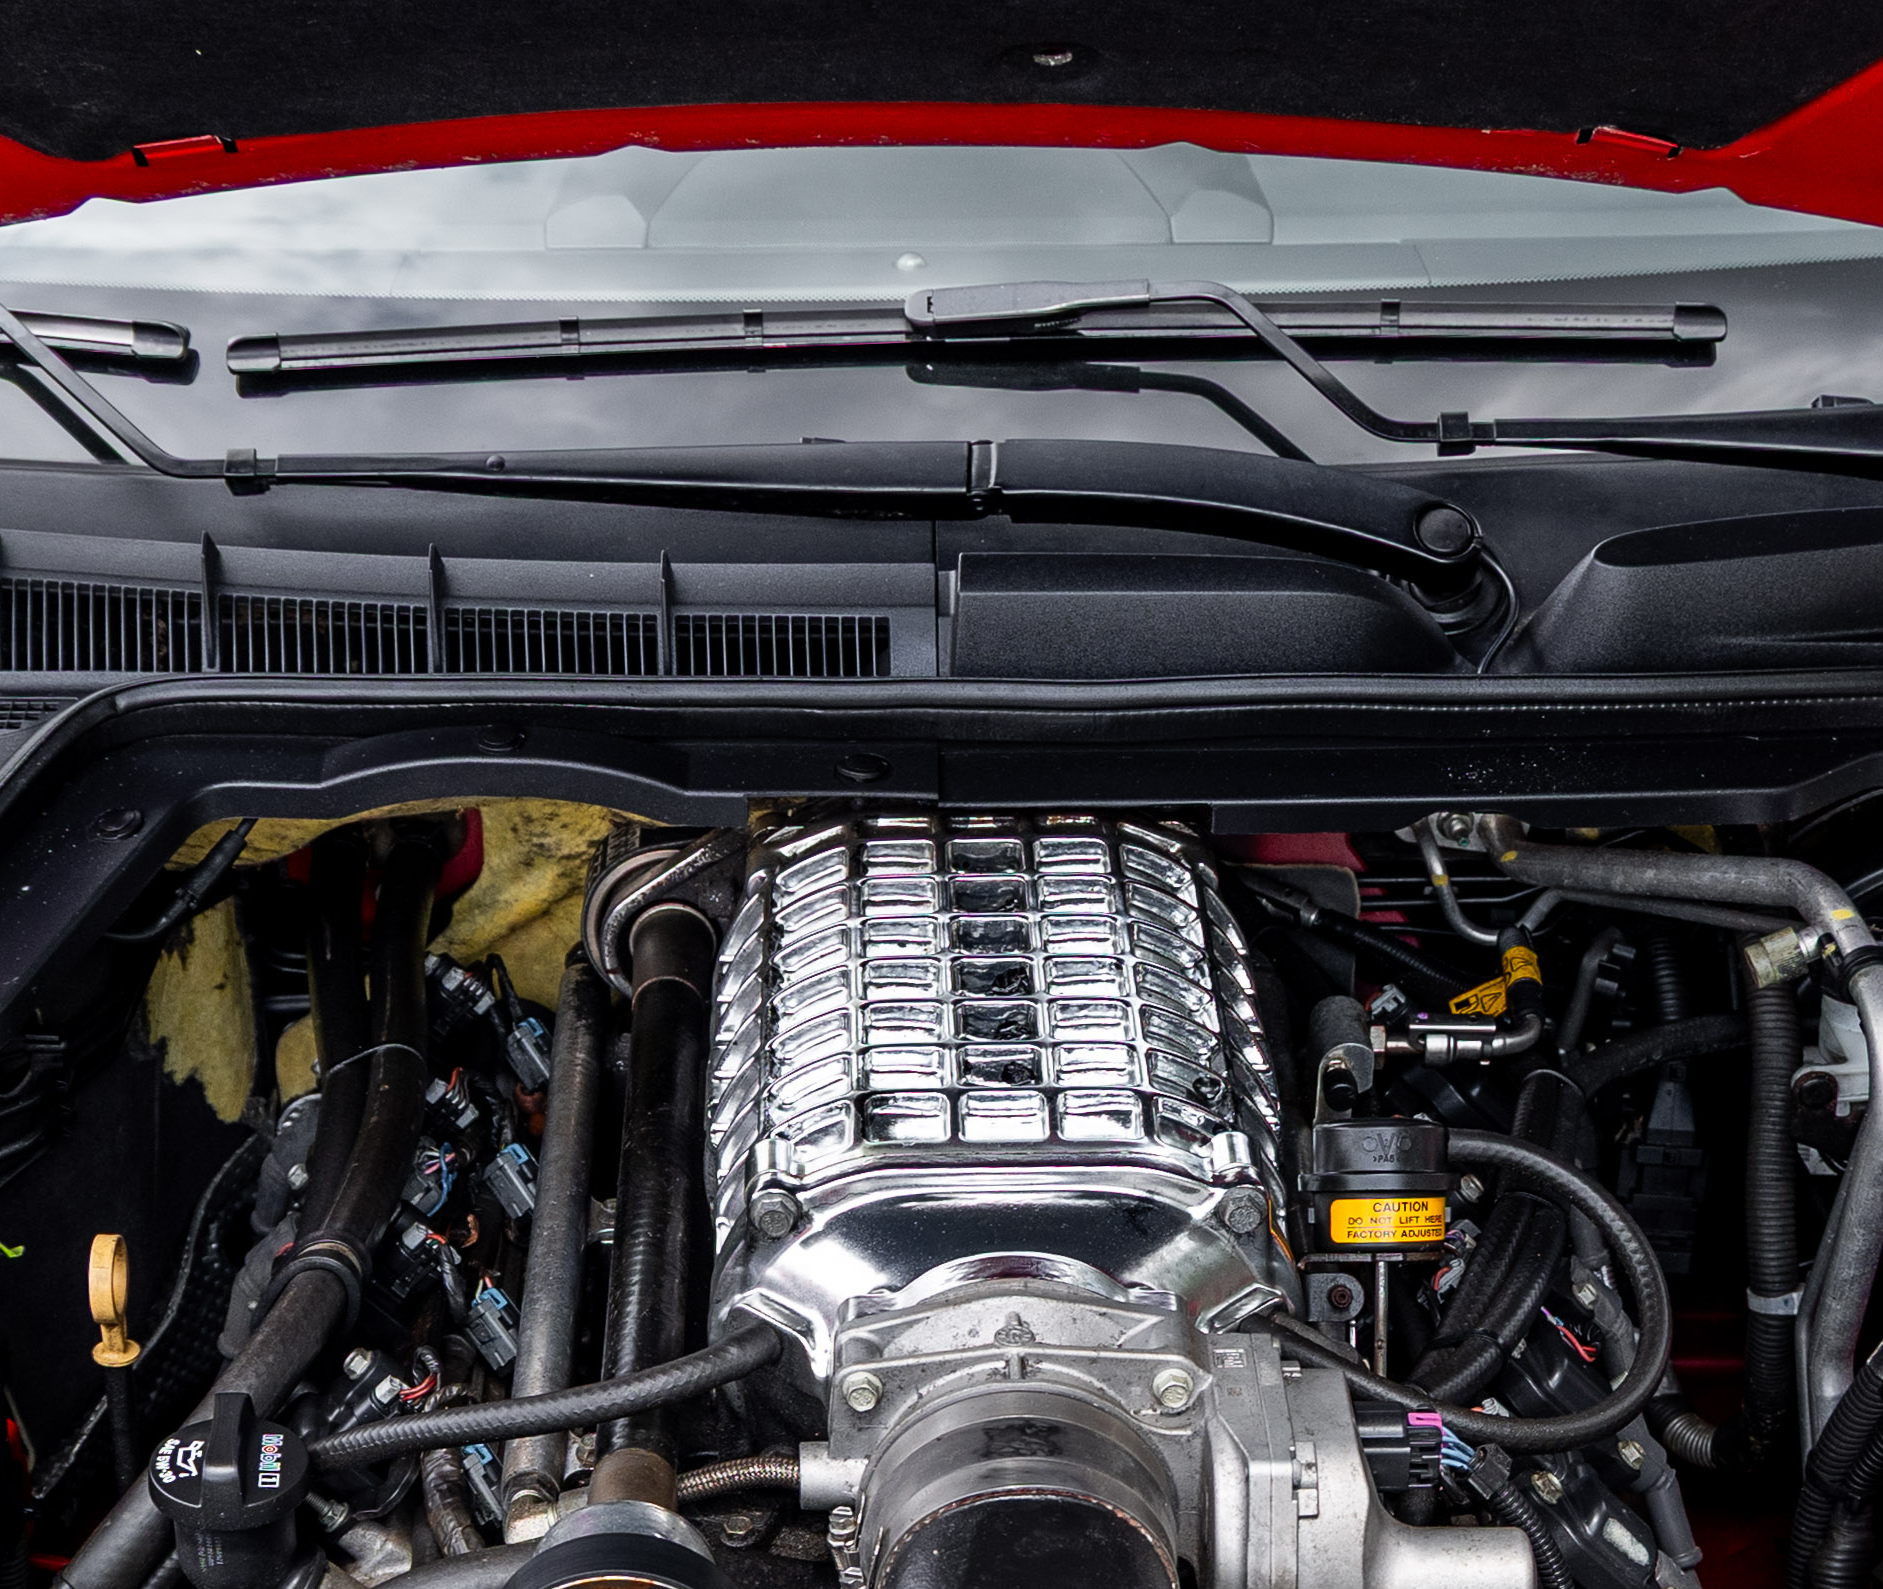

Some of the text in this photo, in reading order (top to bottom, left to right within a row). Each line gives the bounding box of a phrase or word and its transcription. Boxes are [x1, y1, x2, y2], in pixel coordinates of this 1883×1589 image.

[1373, 1201, 1428, 1213] CAUTION
[1348, 1215, 1442, 1225] DO NOT LIFT HERE
[1347, 1228, 1442, 1239] FACTORY ADJUSTED
[258, 1433, 284, 1472] Mobil
[155, 1438, 180, 1483] SAE 5W-30
